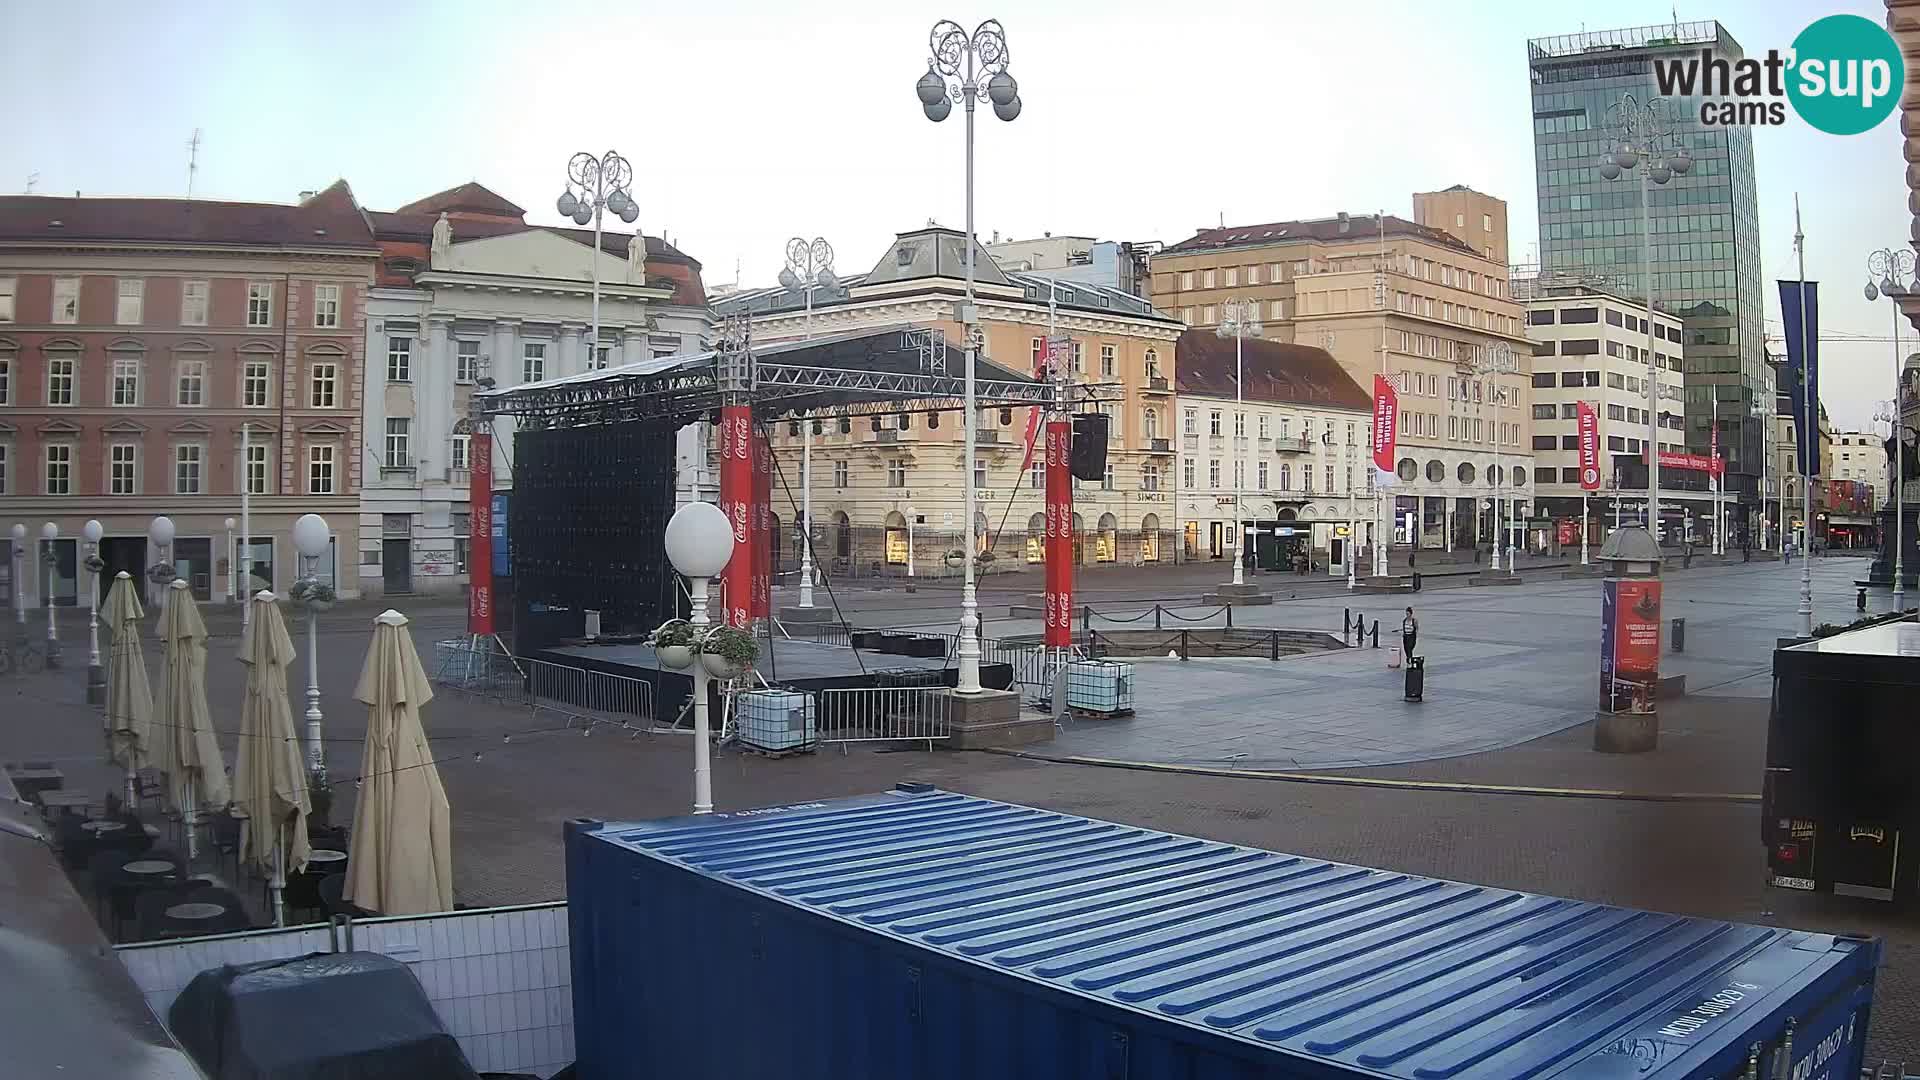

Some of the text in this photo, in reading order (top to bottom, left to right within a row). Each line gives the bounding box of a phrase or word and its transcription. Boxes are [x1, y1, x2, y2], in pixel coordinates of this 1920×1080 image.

[735, 416, 748, 460] Coca-Cola
[1376, 417, 1384, 454] EMBASSY
[1384, 405, 1393, 443] CROATIAN
[1583, 414, 1594, 465] MI HRVATI
[961, 490, 996, 500] SGER
[735, 500, 747, 543] Coca-Cola
[1060, 592, 1069, 628] Coca-Cola
[1657, 1016, 1708, 1038] MCDU
[1690, 989, 1745, 1017] 300629
